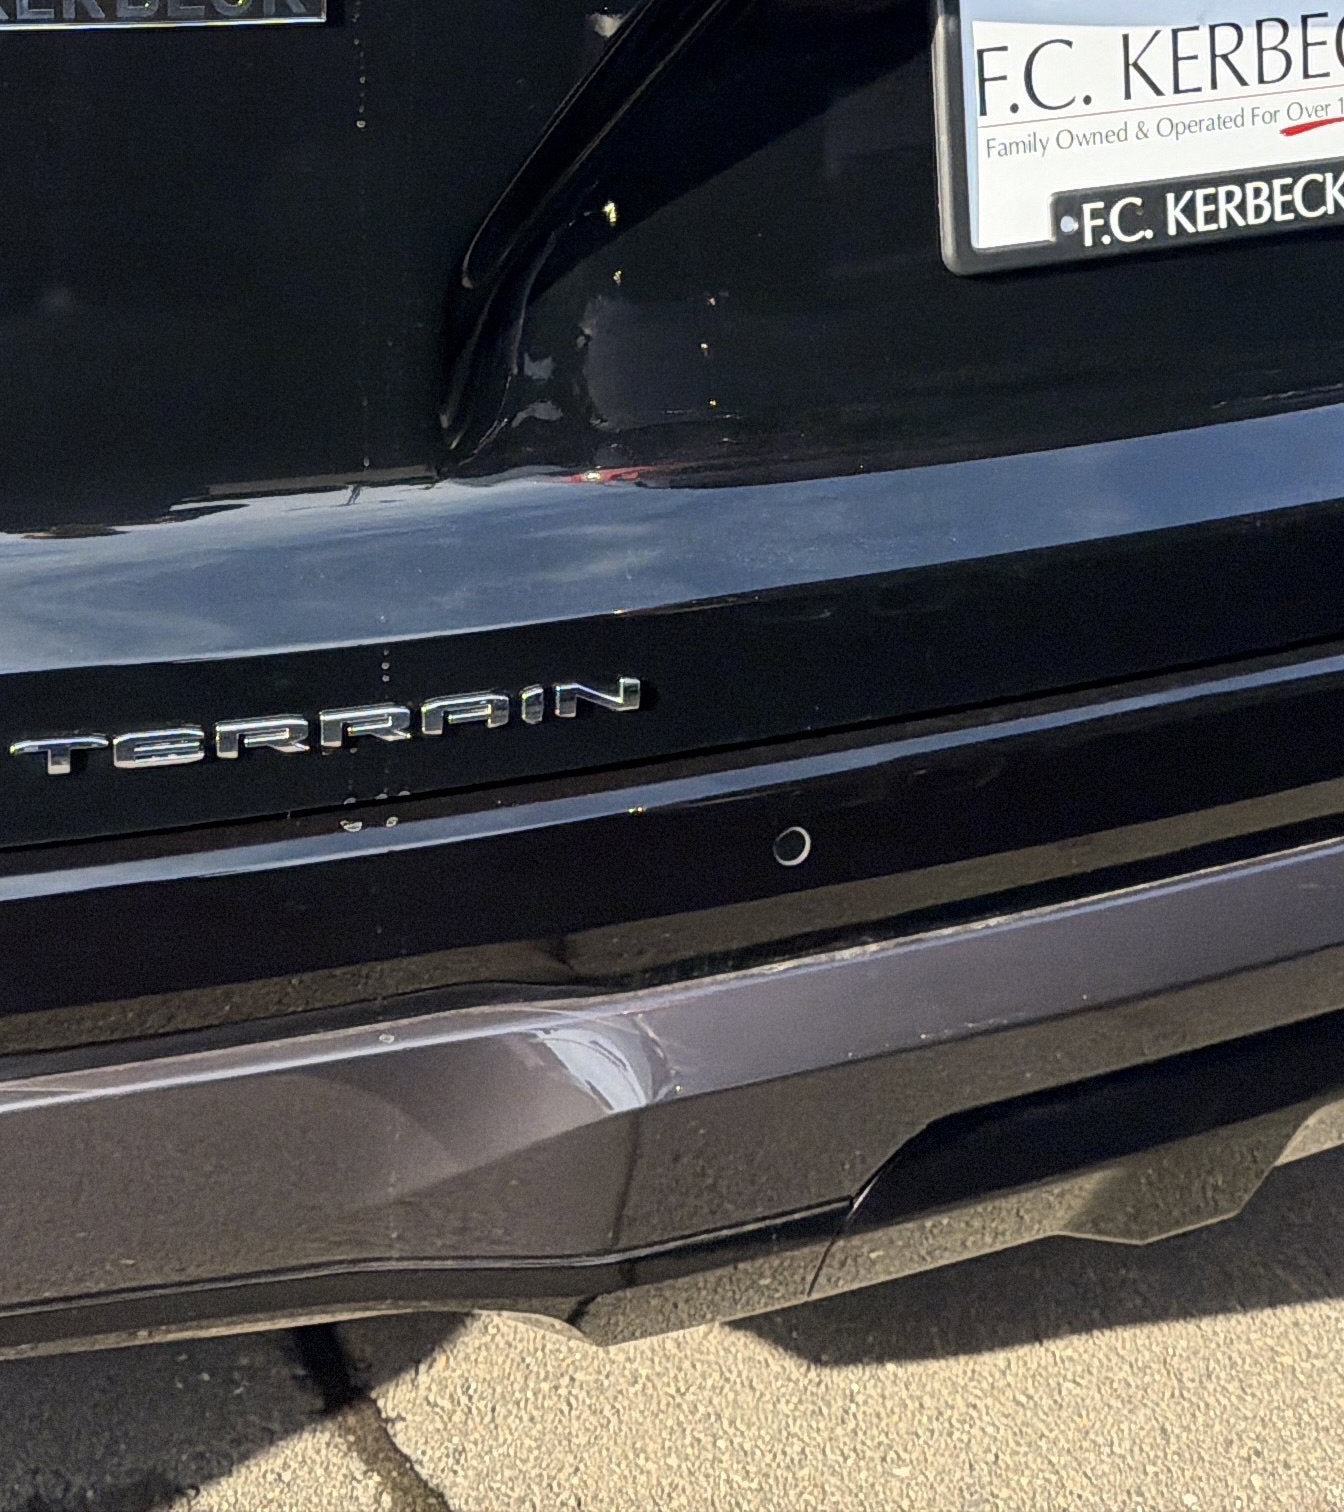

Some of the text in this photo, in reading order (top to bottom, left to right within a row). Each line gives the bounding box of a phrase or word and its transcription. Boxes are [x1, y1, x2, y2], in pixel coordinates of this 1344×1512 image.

[975, 37, 1093, 117] F.C.
[986, 131, 1050, 159] Family
[1056, 121, 1129, 151] Owned
[1135, 120, 1150, 140] &
[1156, 108, 1246, 143] Operated
[1252, 105, 1280, 126] For
[1286, 100, 1332, 123] Over
[1081, 195, 1154, 247] F.C.
[8, 676, 641, 776] TERRAIN
